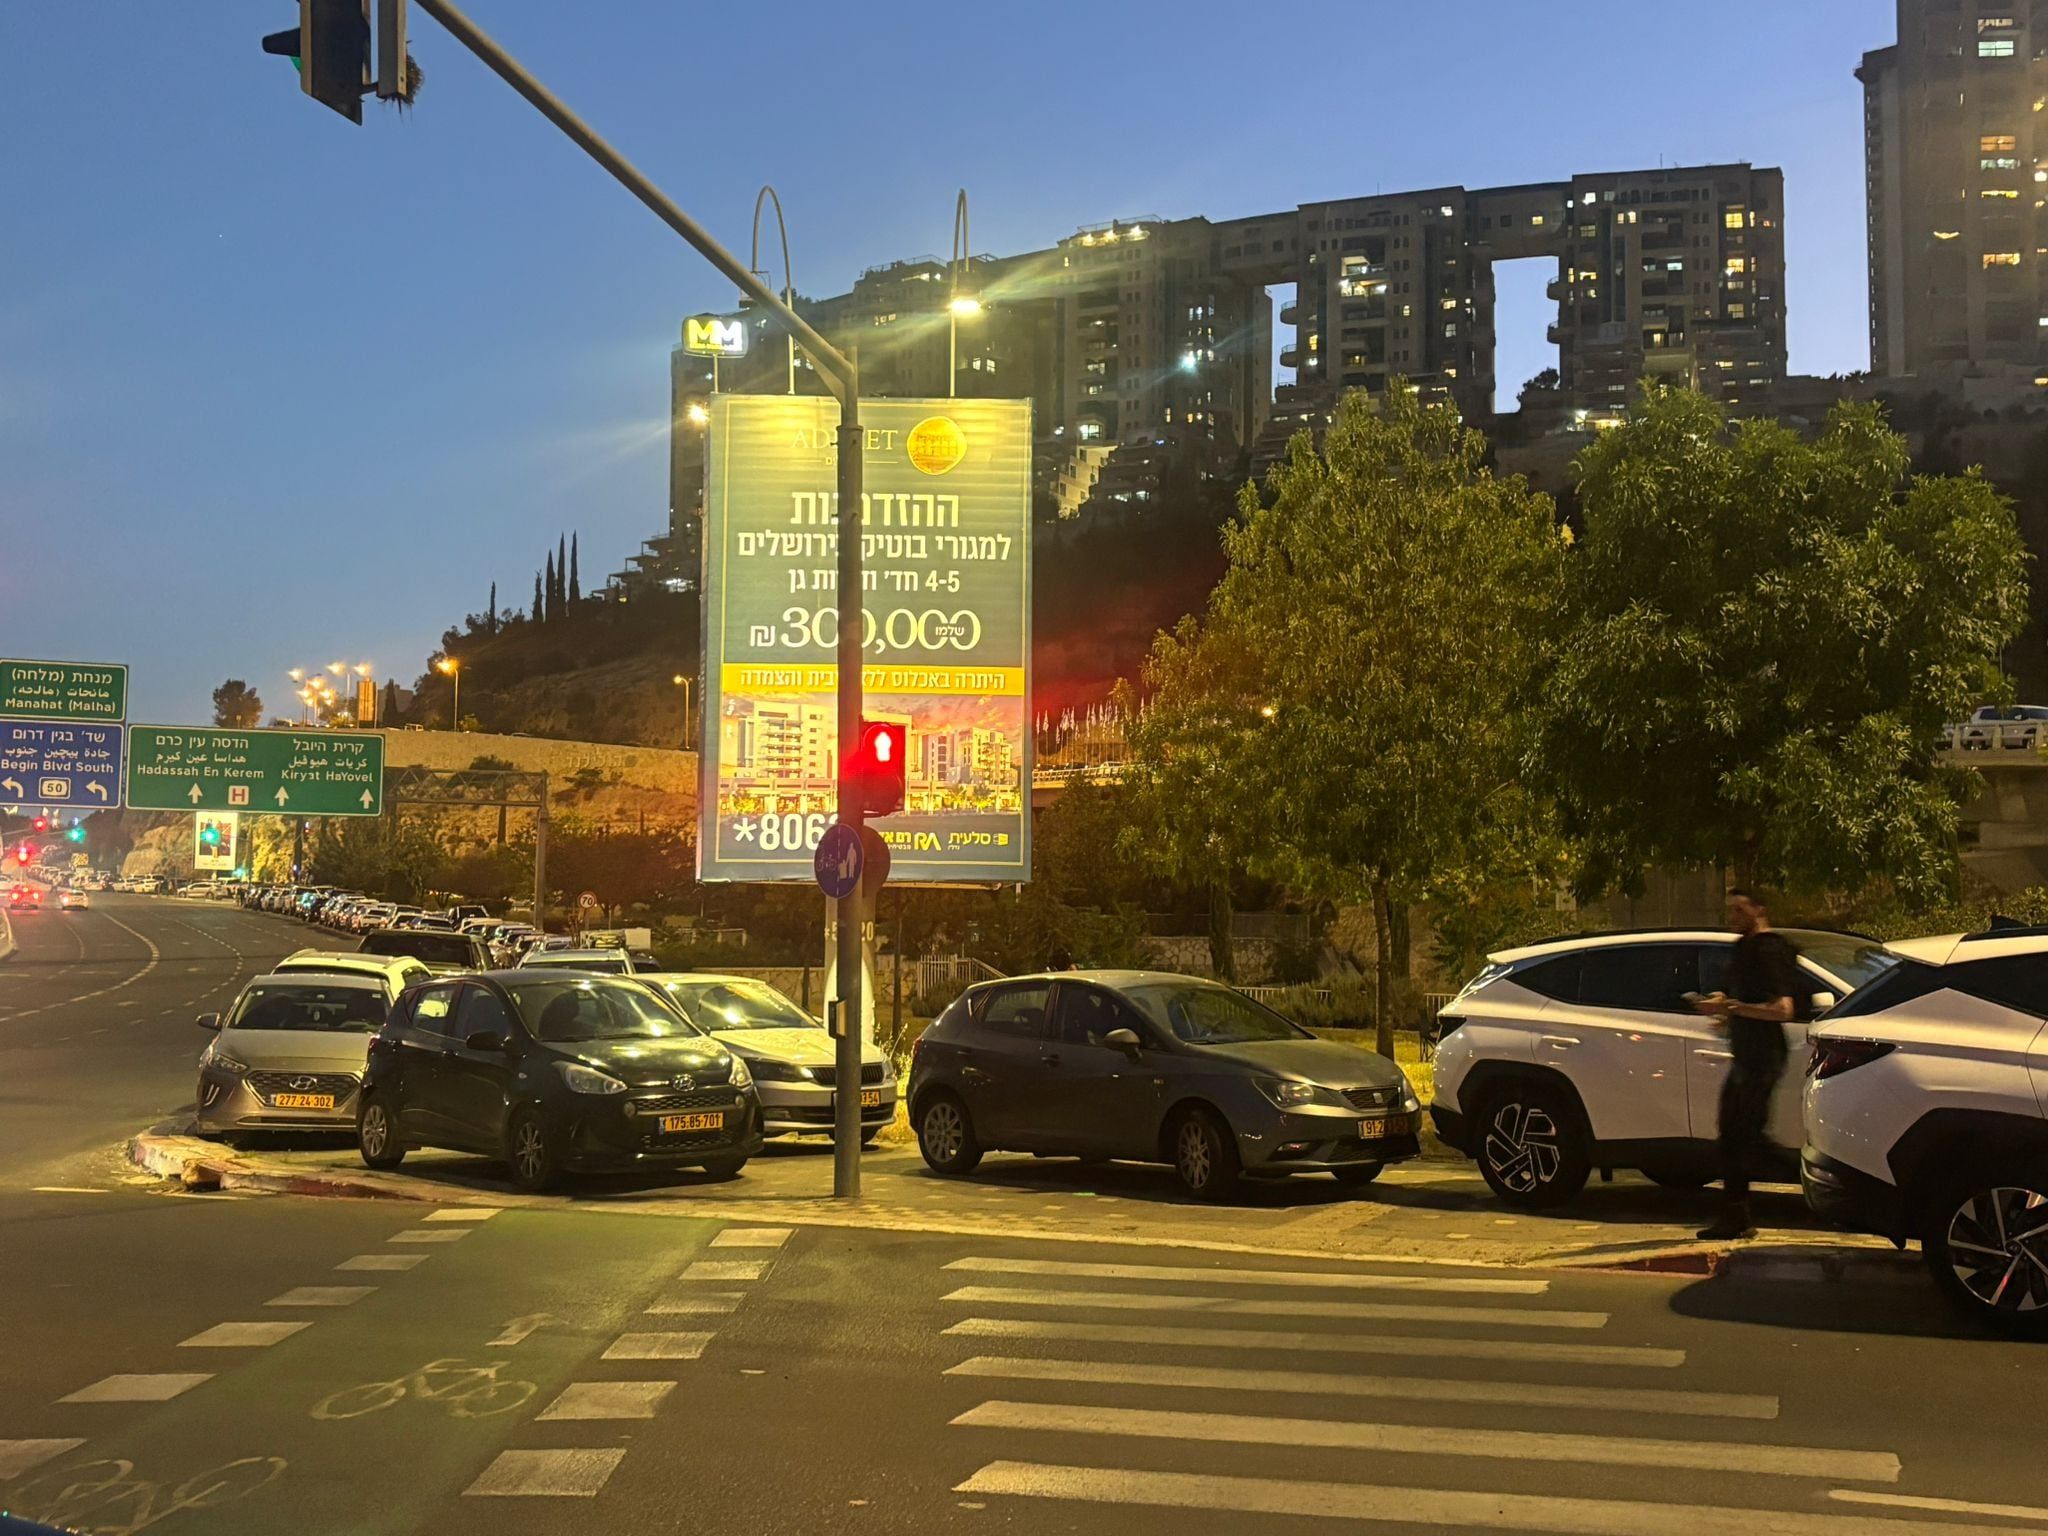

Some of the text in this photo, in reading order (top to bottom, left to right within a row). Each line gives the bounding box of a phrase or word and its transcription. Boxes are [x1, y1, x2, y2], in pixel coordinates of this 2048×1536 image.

[738, 529, 1012, 561] למגורי בוטיק ירושלים
[788, 569, 806, 593] גן
[925, 570, 960, 592] 4-5
[12, 668, 113, 684] מנחת (מלחה)
[741, 669, 803, 686] והצמדה
[808, 670, 838, 687] בית
[892, 669, 950, 688] באכלוס
[955, 672, 1004, 689] היתרה
[5, 698, 116, 713] Manahat (Malha)
[13, 728, 44, 740] דרום
[51, 730, 74, 743] בגין
[156, 735, 249, 749] הדסה עין כרם
[293, 738, 365, 755] קרית היובל
[1, 759, 114, 773] Begin Blvd South
[186, 753, 208, 764] عين
[137, 764, 265, 779] Hadassah En Kerem
[281, 769, 374, 783] Kiryat HaYovel
[47, 783, 62, 793] 50
[231, 787, 246, 803] H
[948, 831, 991, 845] סלעית
[582, 896, 593, 906] 70
